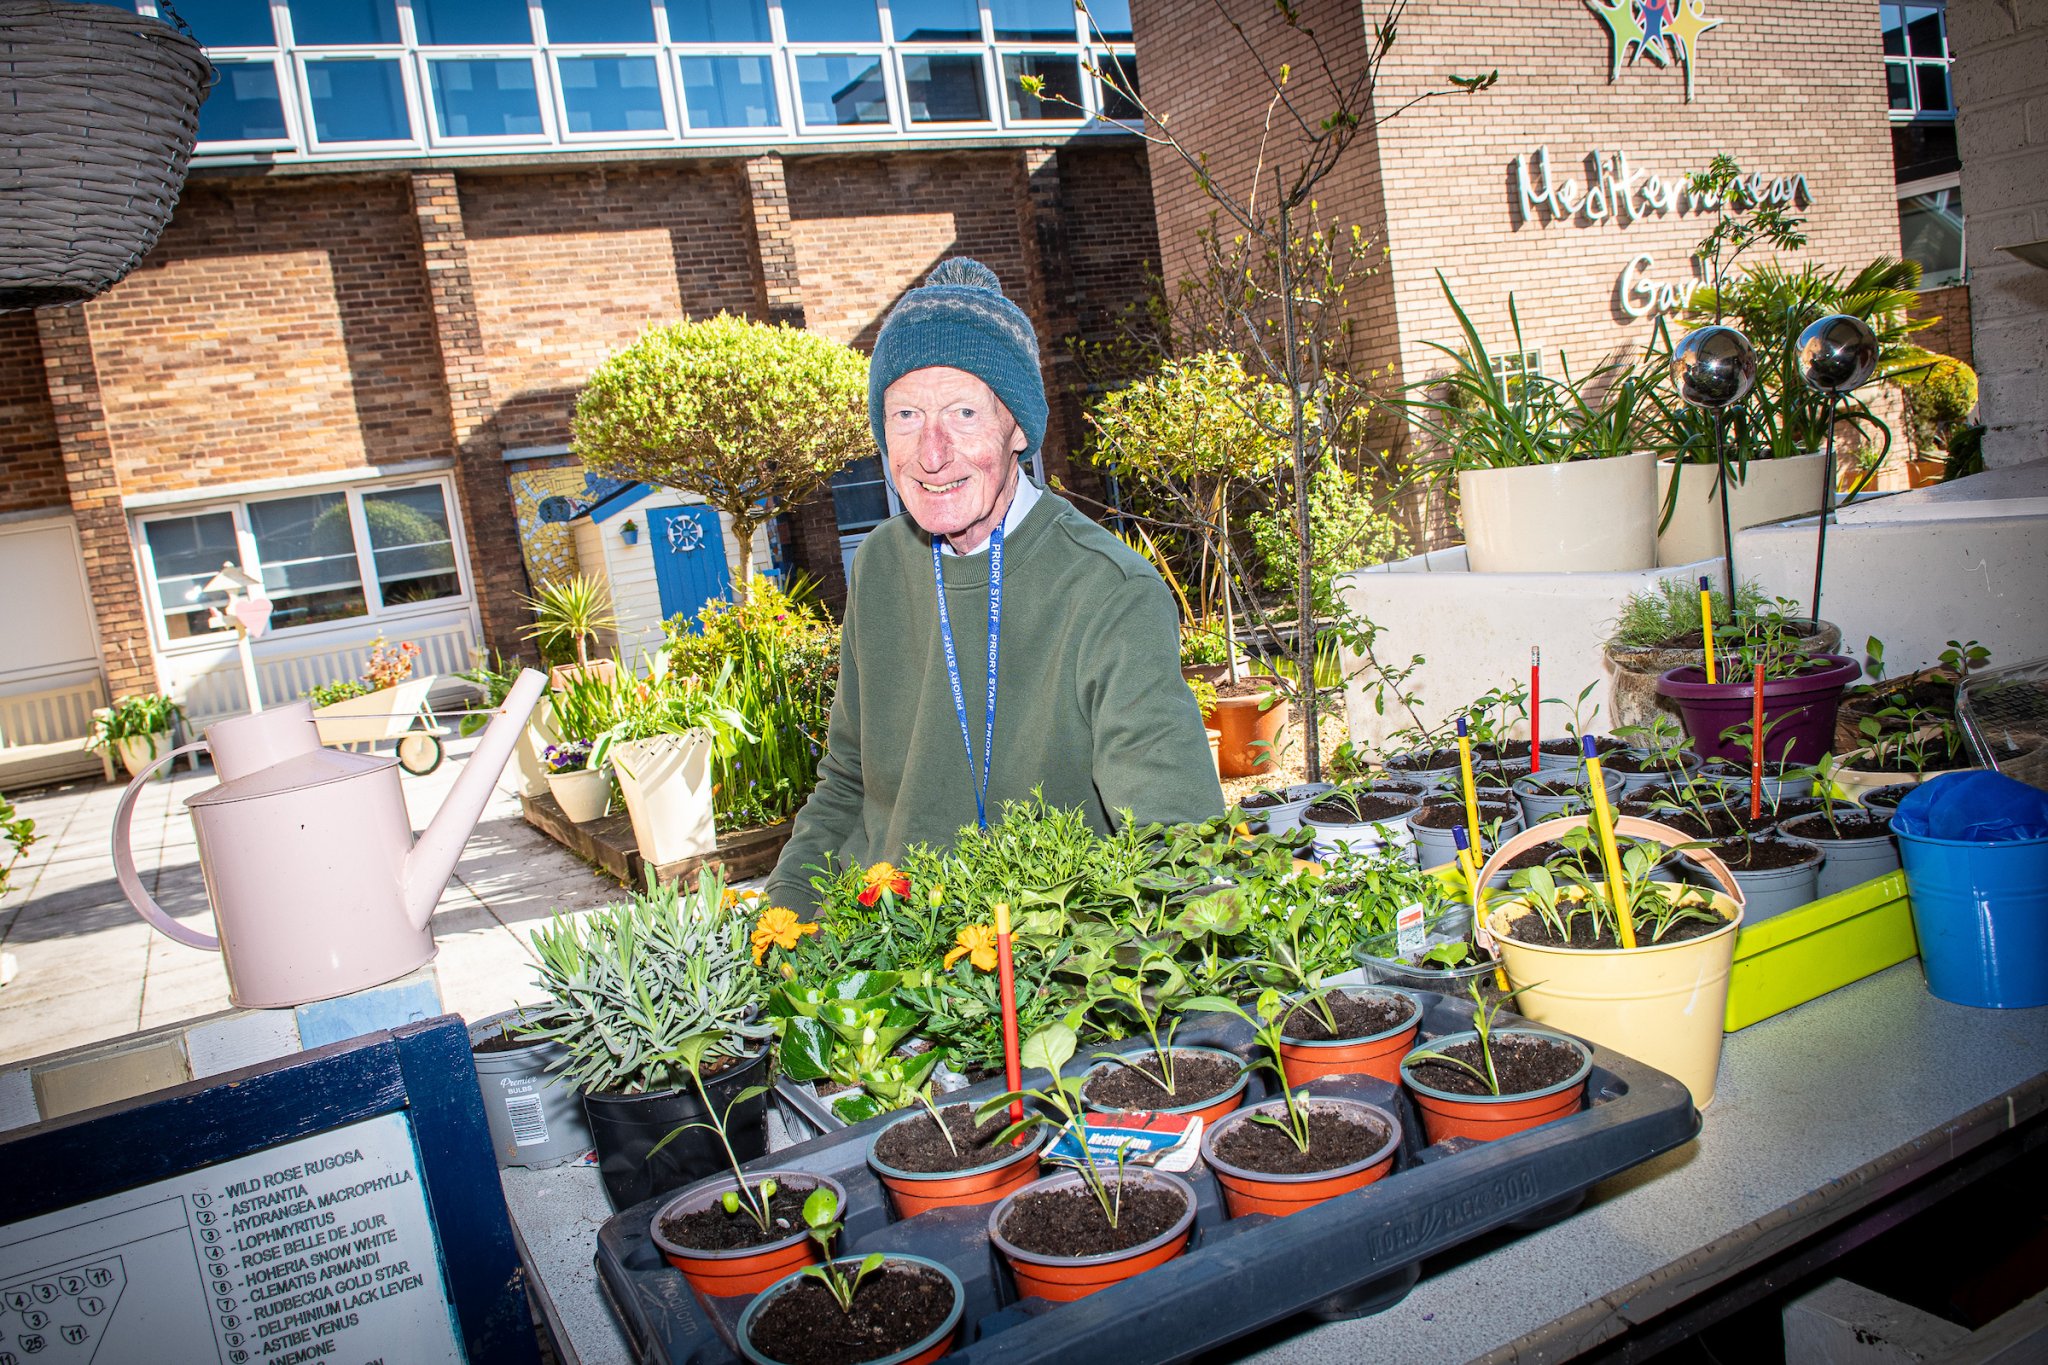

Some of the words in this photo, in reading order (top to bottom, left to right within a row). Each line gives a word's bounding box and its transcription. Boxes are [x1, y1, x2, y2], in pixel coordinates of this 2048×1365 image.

[933, 547, 942, 580] STAFF
[991, 543, 1001, 585] PRIORY
[937, 584, 948, 623] PRIORY
[990, 588, 1000, 622] STAFF
[945, 634, 956, 668] STAFF
[987, 634, 997, 677] PRIORY
[951, 668, 965, 710] PRIORY
[986, 679, 996, 712] STAFF
[985, 723, 993, 764] PRIORY
[500, 1076, 537, 1088] Premier
[508, 1085, 533, 1094] BULBS
[225, 1178, 260, 1199] WILD
[264, 1166, 303, 1188] ROSE
[305, 1149, 364, 1176] RUGOSA
[232, 1184, 308, 1217] ASTRANTIA
[234, 1199, 320, 1234] HYDRANGEA
[318, 1170, 413, 1207] MACROPHYLLA
[238, 1212, 336, 1251] LOPHMYRITUS
[242, 1246, 282, 1269] ROSE
[284, 1232, 326, 1256] BELLE
[328, 1226, 348, 1242] DE
[350, 1214, 387, 1236] JOUR
[246, 1258, 309, 1287] HOHERIA
[310, 1243, 351, 1266] SNOW
[354, 1229, 397, 1253] WHITE
[250, 1272, 317, 1303] CLEMATIS
[319, 1251, 380, 1281] ARMANDI
[16, 1295, 23, 1307] 4
[42, 1287, 51, 1298] 3
[68, 1280, 77, 1292] 2
[94, 1271, 108, 1284] 11
[89, 1301, 96, 1311] 1
[254, 1285, 334, 1321] RUDBECKIA
[335, 1272, 373, 1294] GOLD
[375, 1260, 410, 1282] STAR
[258, 1301, 341, 1338] DELPHINIUM
[343, 1289, 379, 1310] LACK
[381, 1274, 423, 1298] LEVEN
[32, 1314, 42, 1326] 3
[68, 1328, 82, 1342] 11
[263, 1329, 312, 1356] ASTIBE
[312, 1312, 359, 1339] VENUS
[26, 1338, 42, 1351] 25
[269, 1340, 337, 1365] ANEMONE
